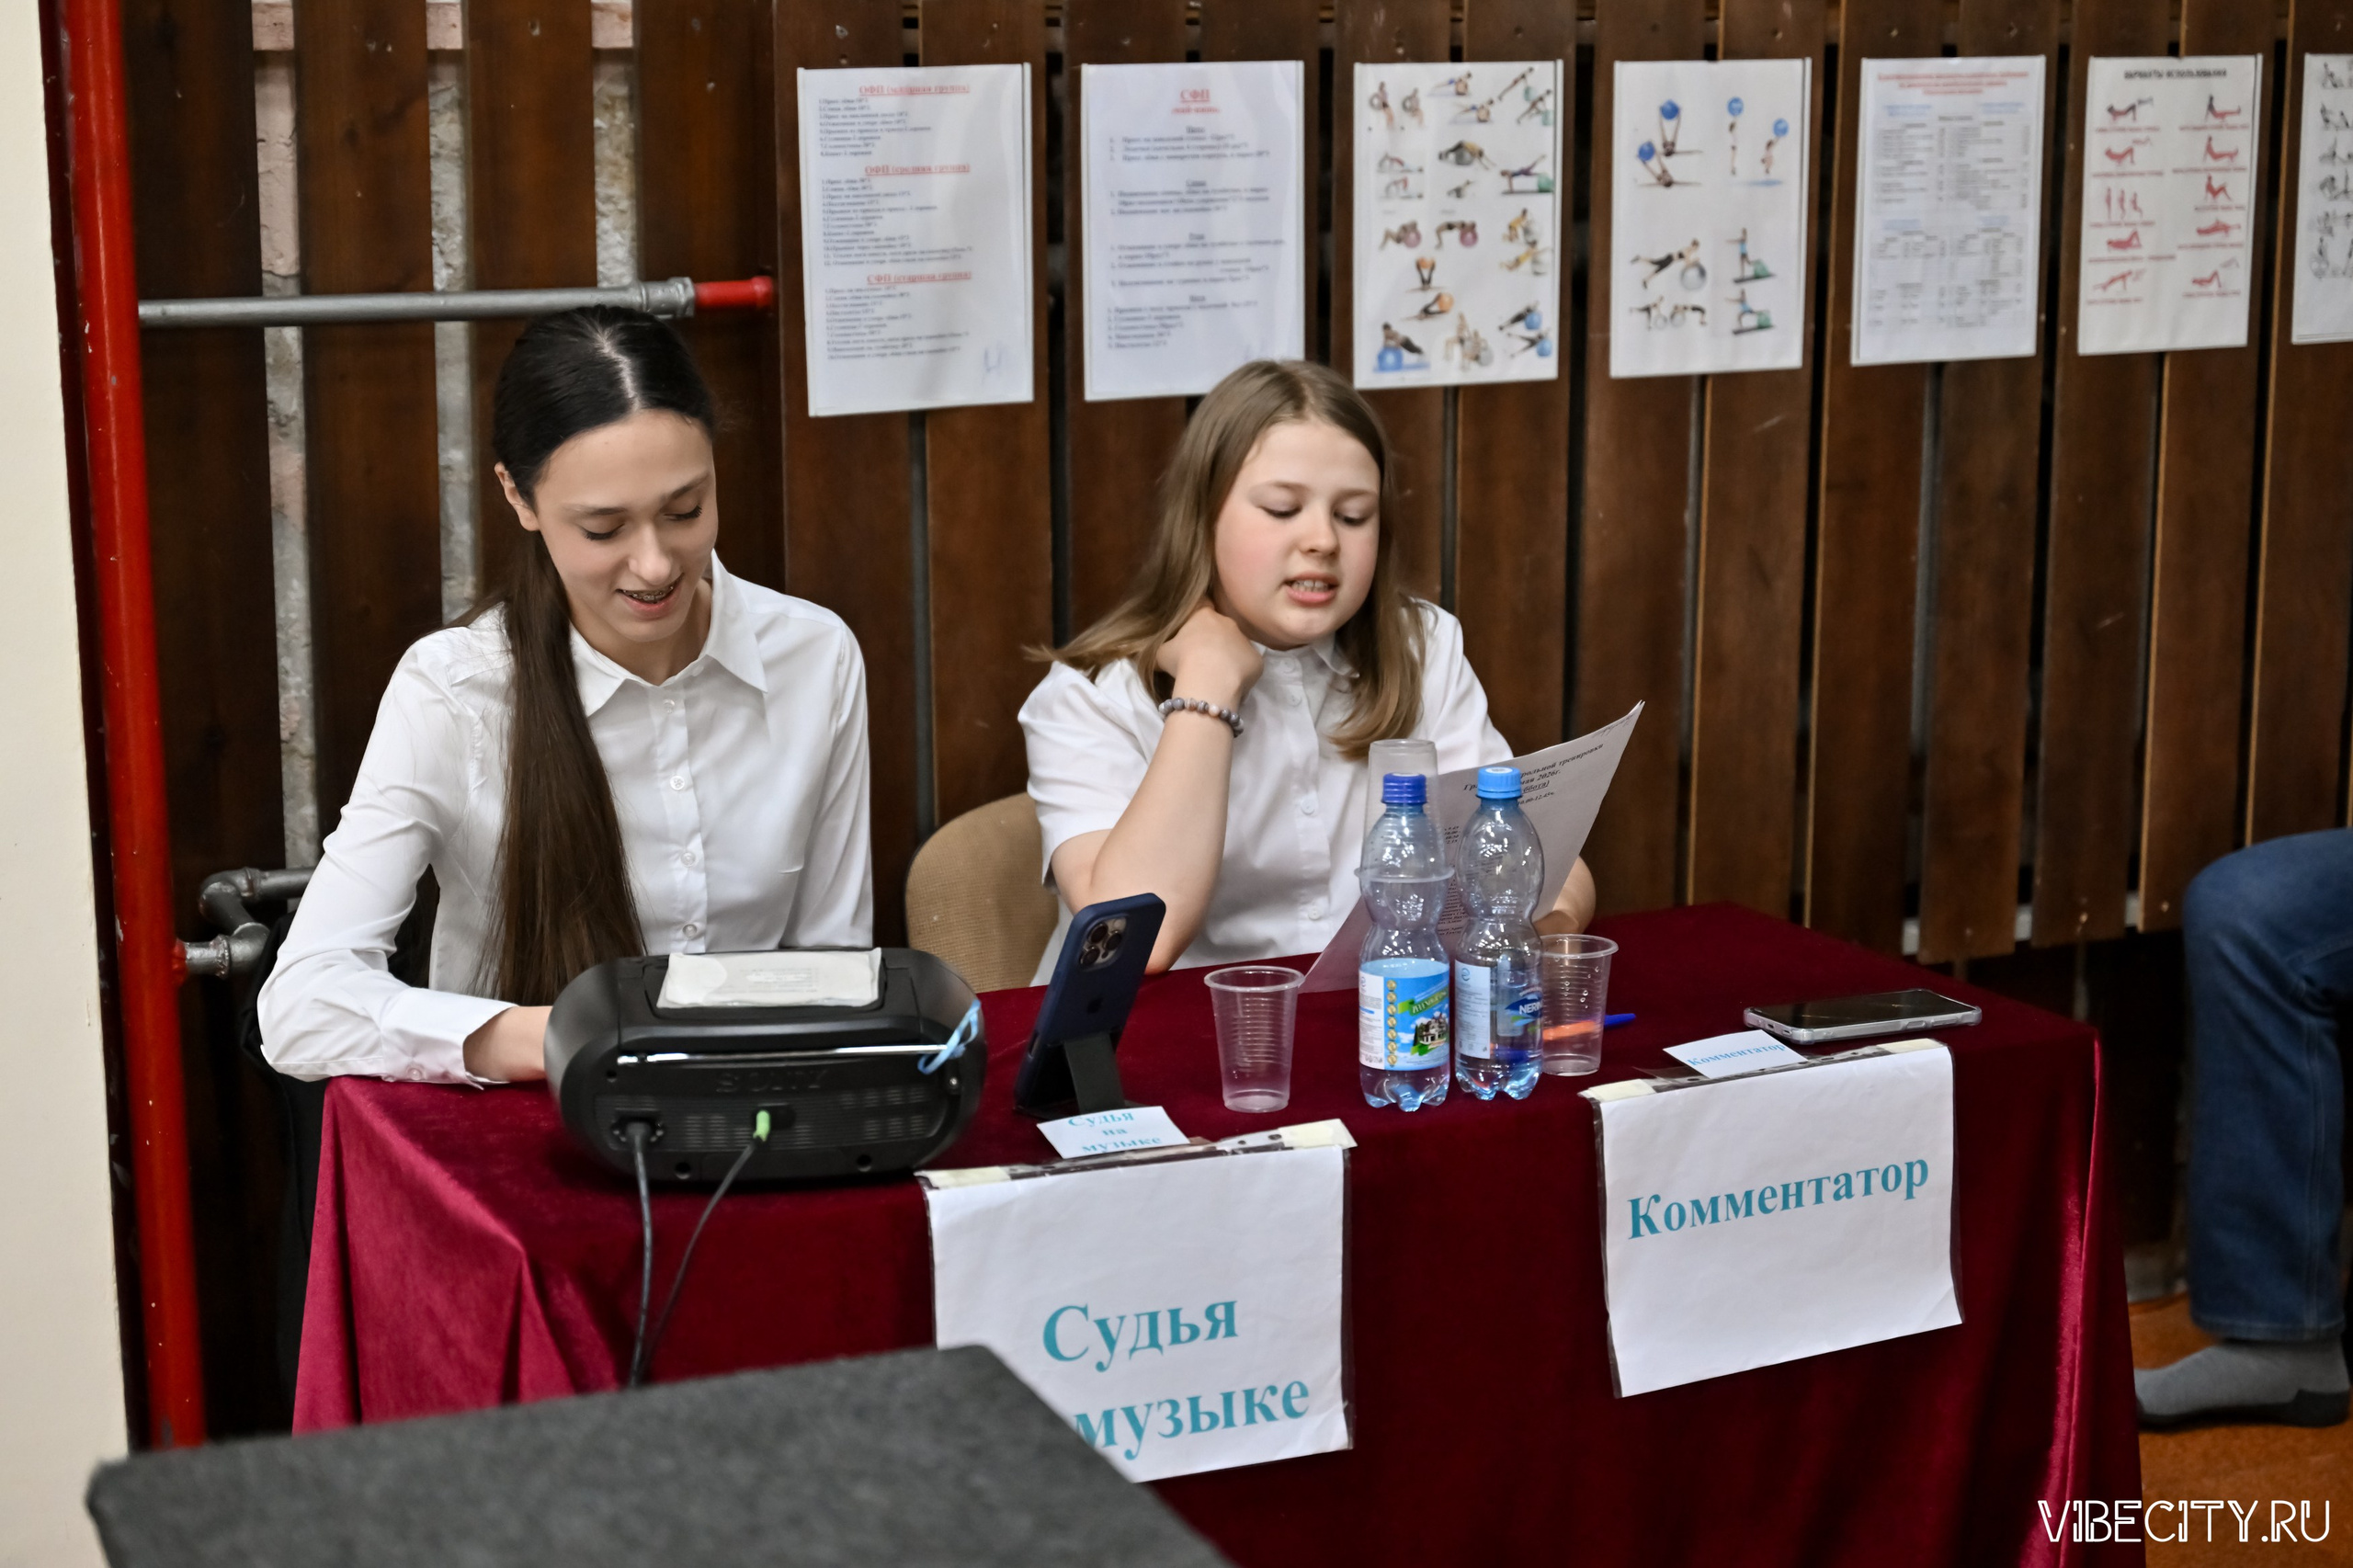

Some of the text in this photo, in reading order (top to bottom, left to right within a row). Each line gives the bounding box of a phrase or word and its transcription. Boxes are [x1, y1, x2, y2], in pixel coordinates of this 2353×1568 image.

[1179, 88, 1211, 103] СФП
[1558, 744, 1604, 767] тренировки
[1522, 780, 1550, 793] ббота)
[1686, 1043, 1787, 1066] Комментатор
[715, 1069, 829, 1093] SONY
[1068, 1112, 1135, 1128] Судья
[1101, 1128, 1128, 1136] на
[1082, 1136, 1163, 1153] музыке
[1626, 1158, 1930, 1240] Комментатор
[1042, 1301, 1239, 1373] Судья
[1074, 1381, 1310, 1460] музыке
